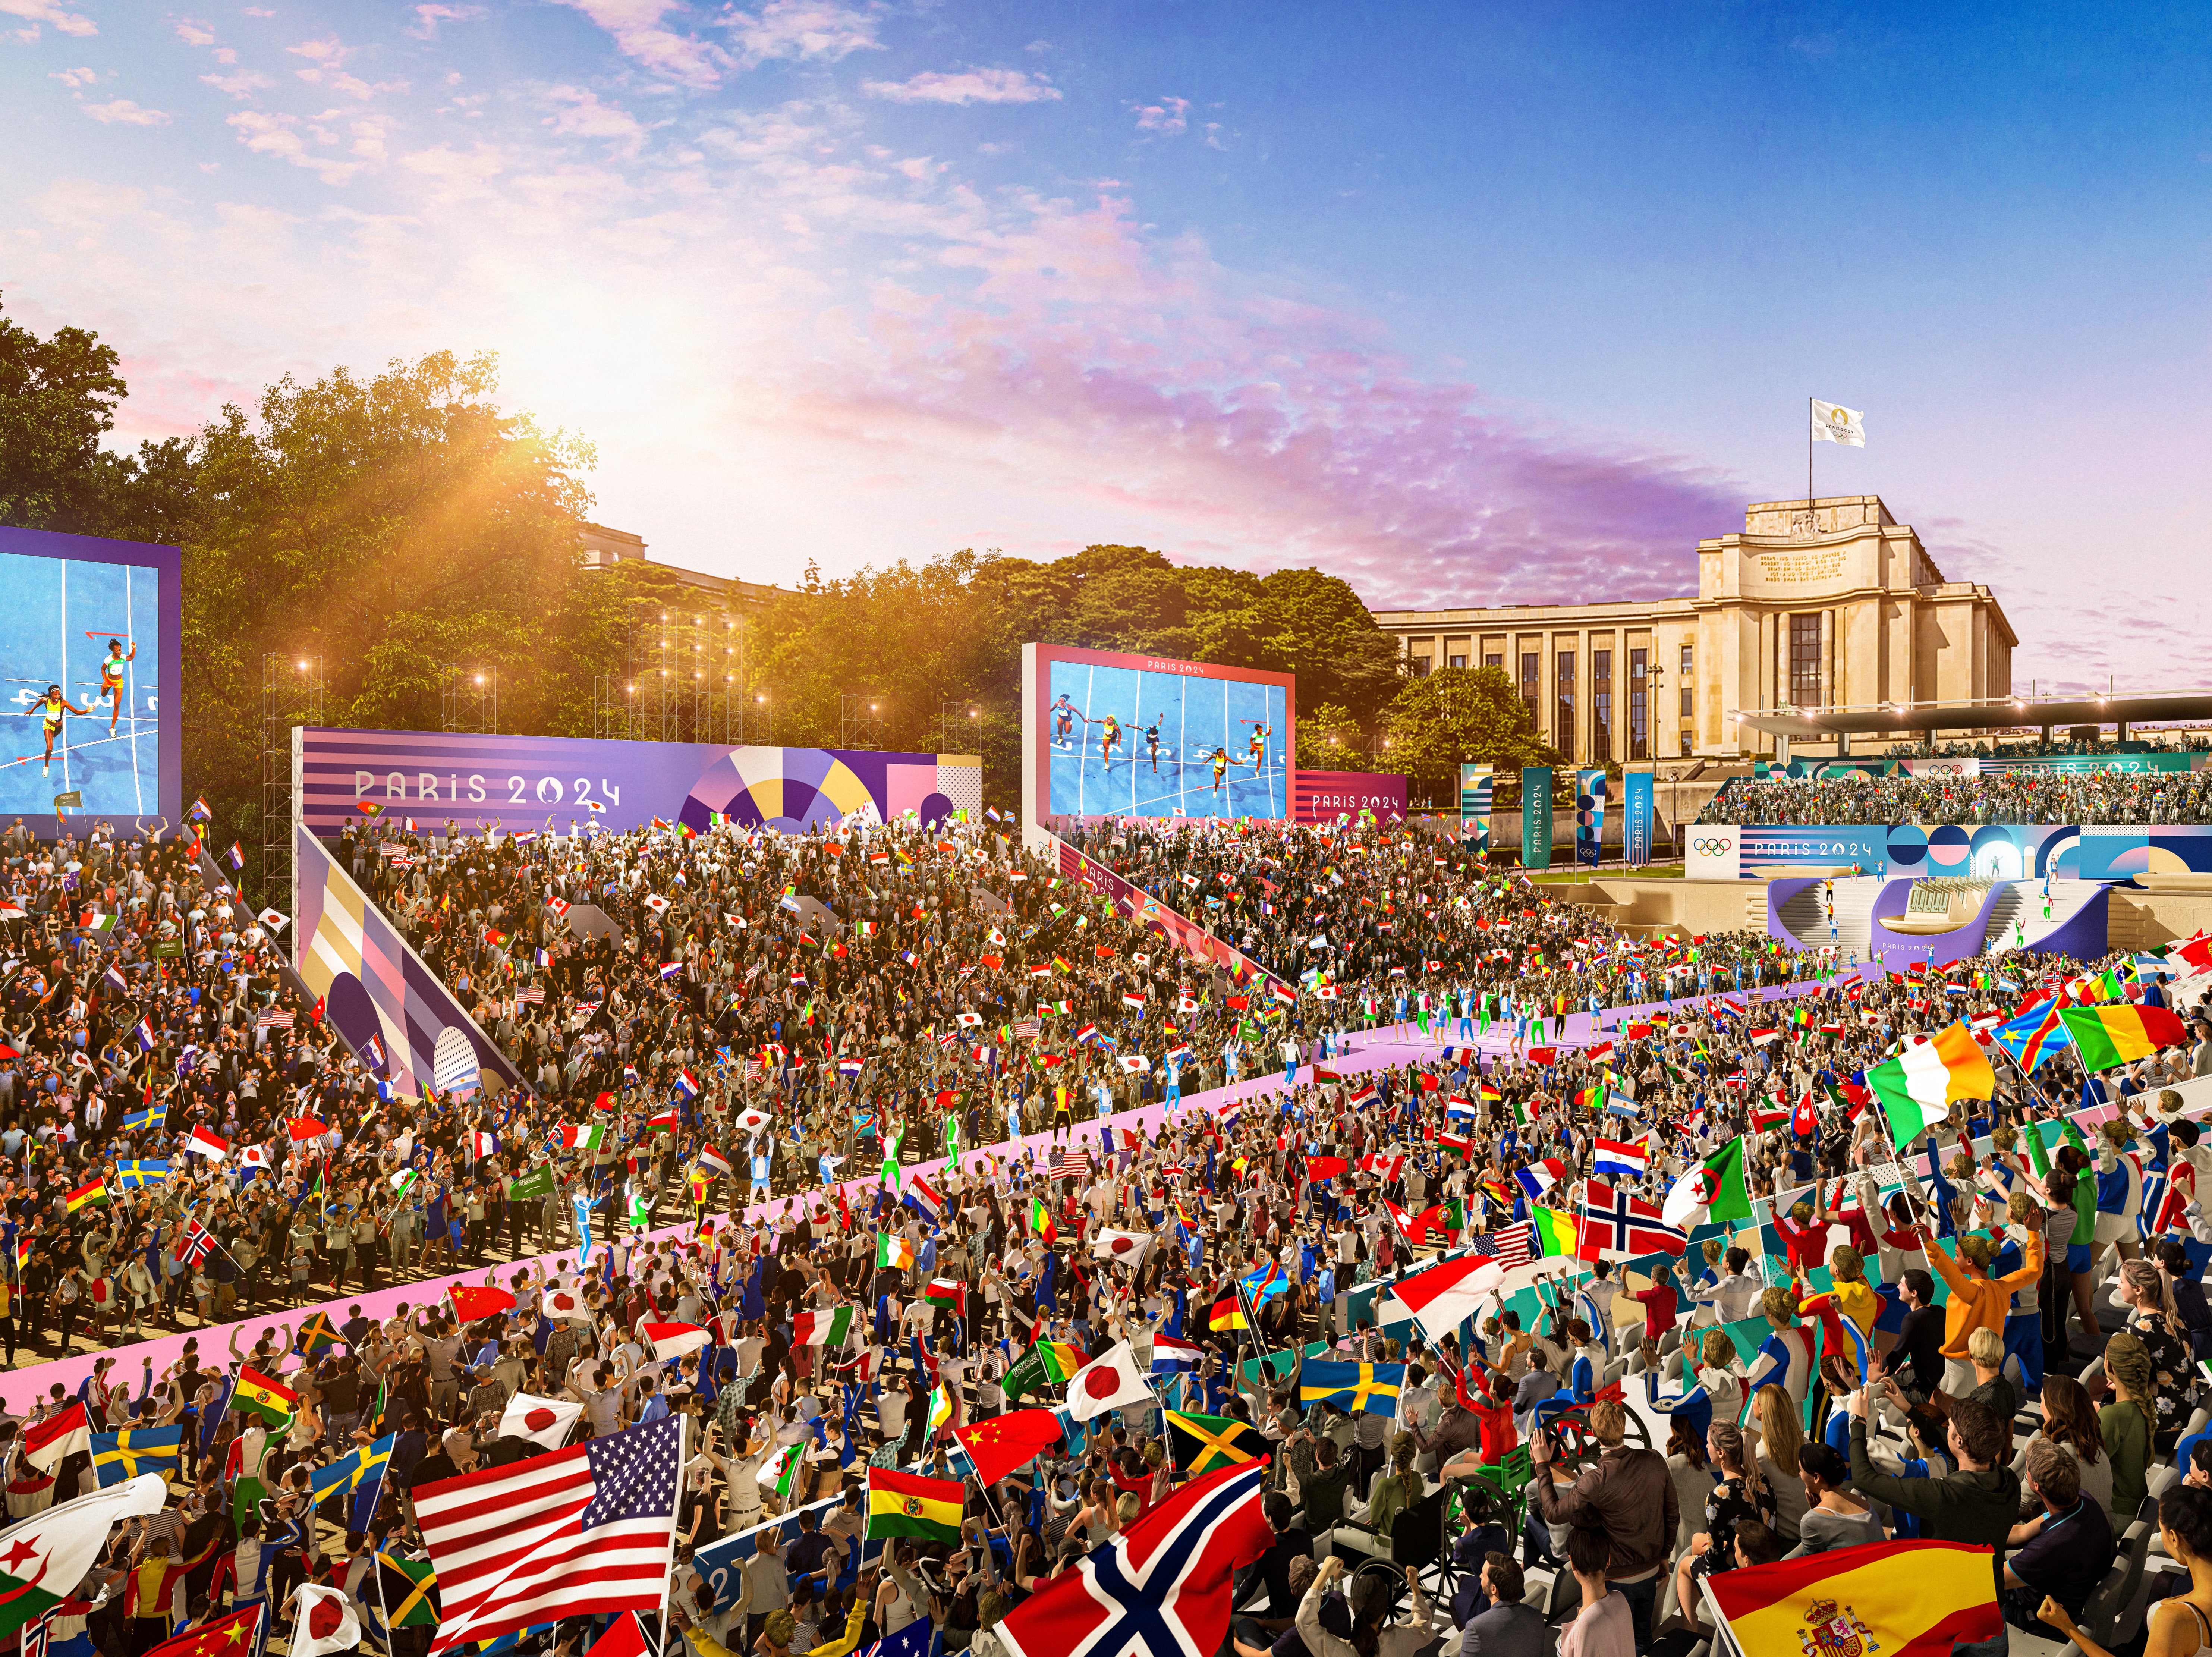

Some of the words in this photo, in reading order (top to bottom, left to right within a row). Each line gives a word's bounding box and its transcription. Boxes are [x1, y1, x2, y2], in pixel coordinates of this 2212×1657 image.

[1180, 664, 1204, 674] 2024
[2089, 761, 2159, 773] 2024
[507, 776, 620, 806] 2024
[1362, 796, 1398, 808] 2024
[1533, 785, 1542, 815] 2024
[1634, 789, 1643, 815] 2024
[1819, 843, 1871, 856] 2024
[1804, 1642, 1815, 1651] PLVS
